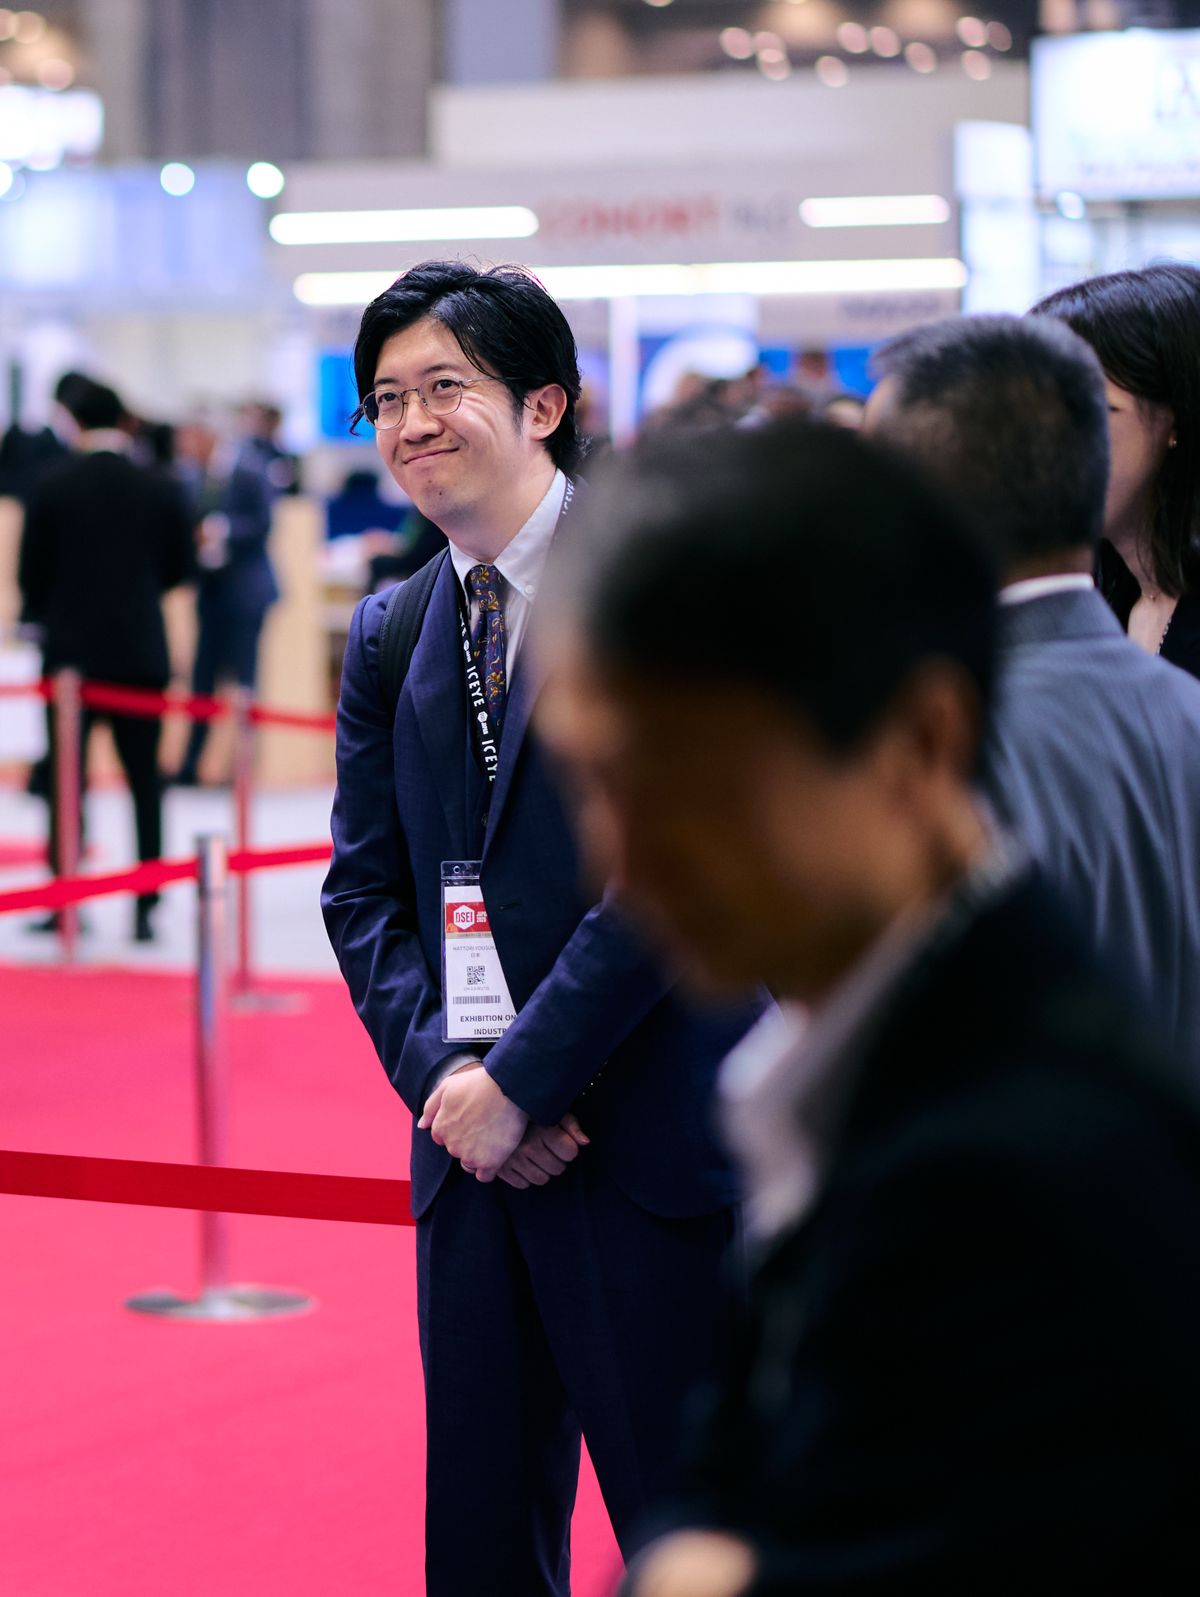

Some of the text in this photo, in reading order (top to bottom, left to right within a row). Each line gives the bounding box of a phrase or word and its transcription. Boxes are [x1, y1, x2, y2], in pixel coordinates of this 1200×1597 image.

[466, 665, 485, 707] ICEYE
[455, 911, 473, 923] DSEI
[460, 1014, 503, 1022] EXHIBITION
